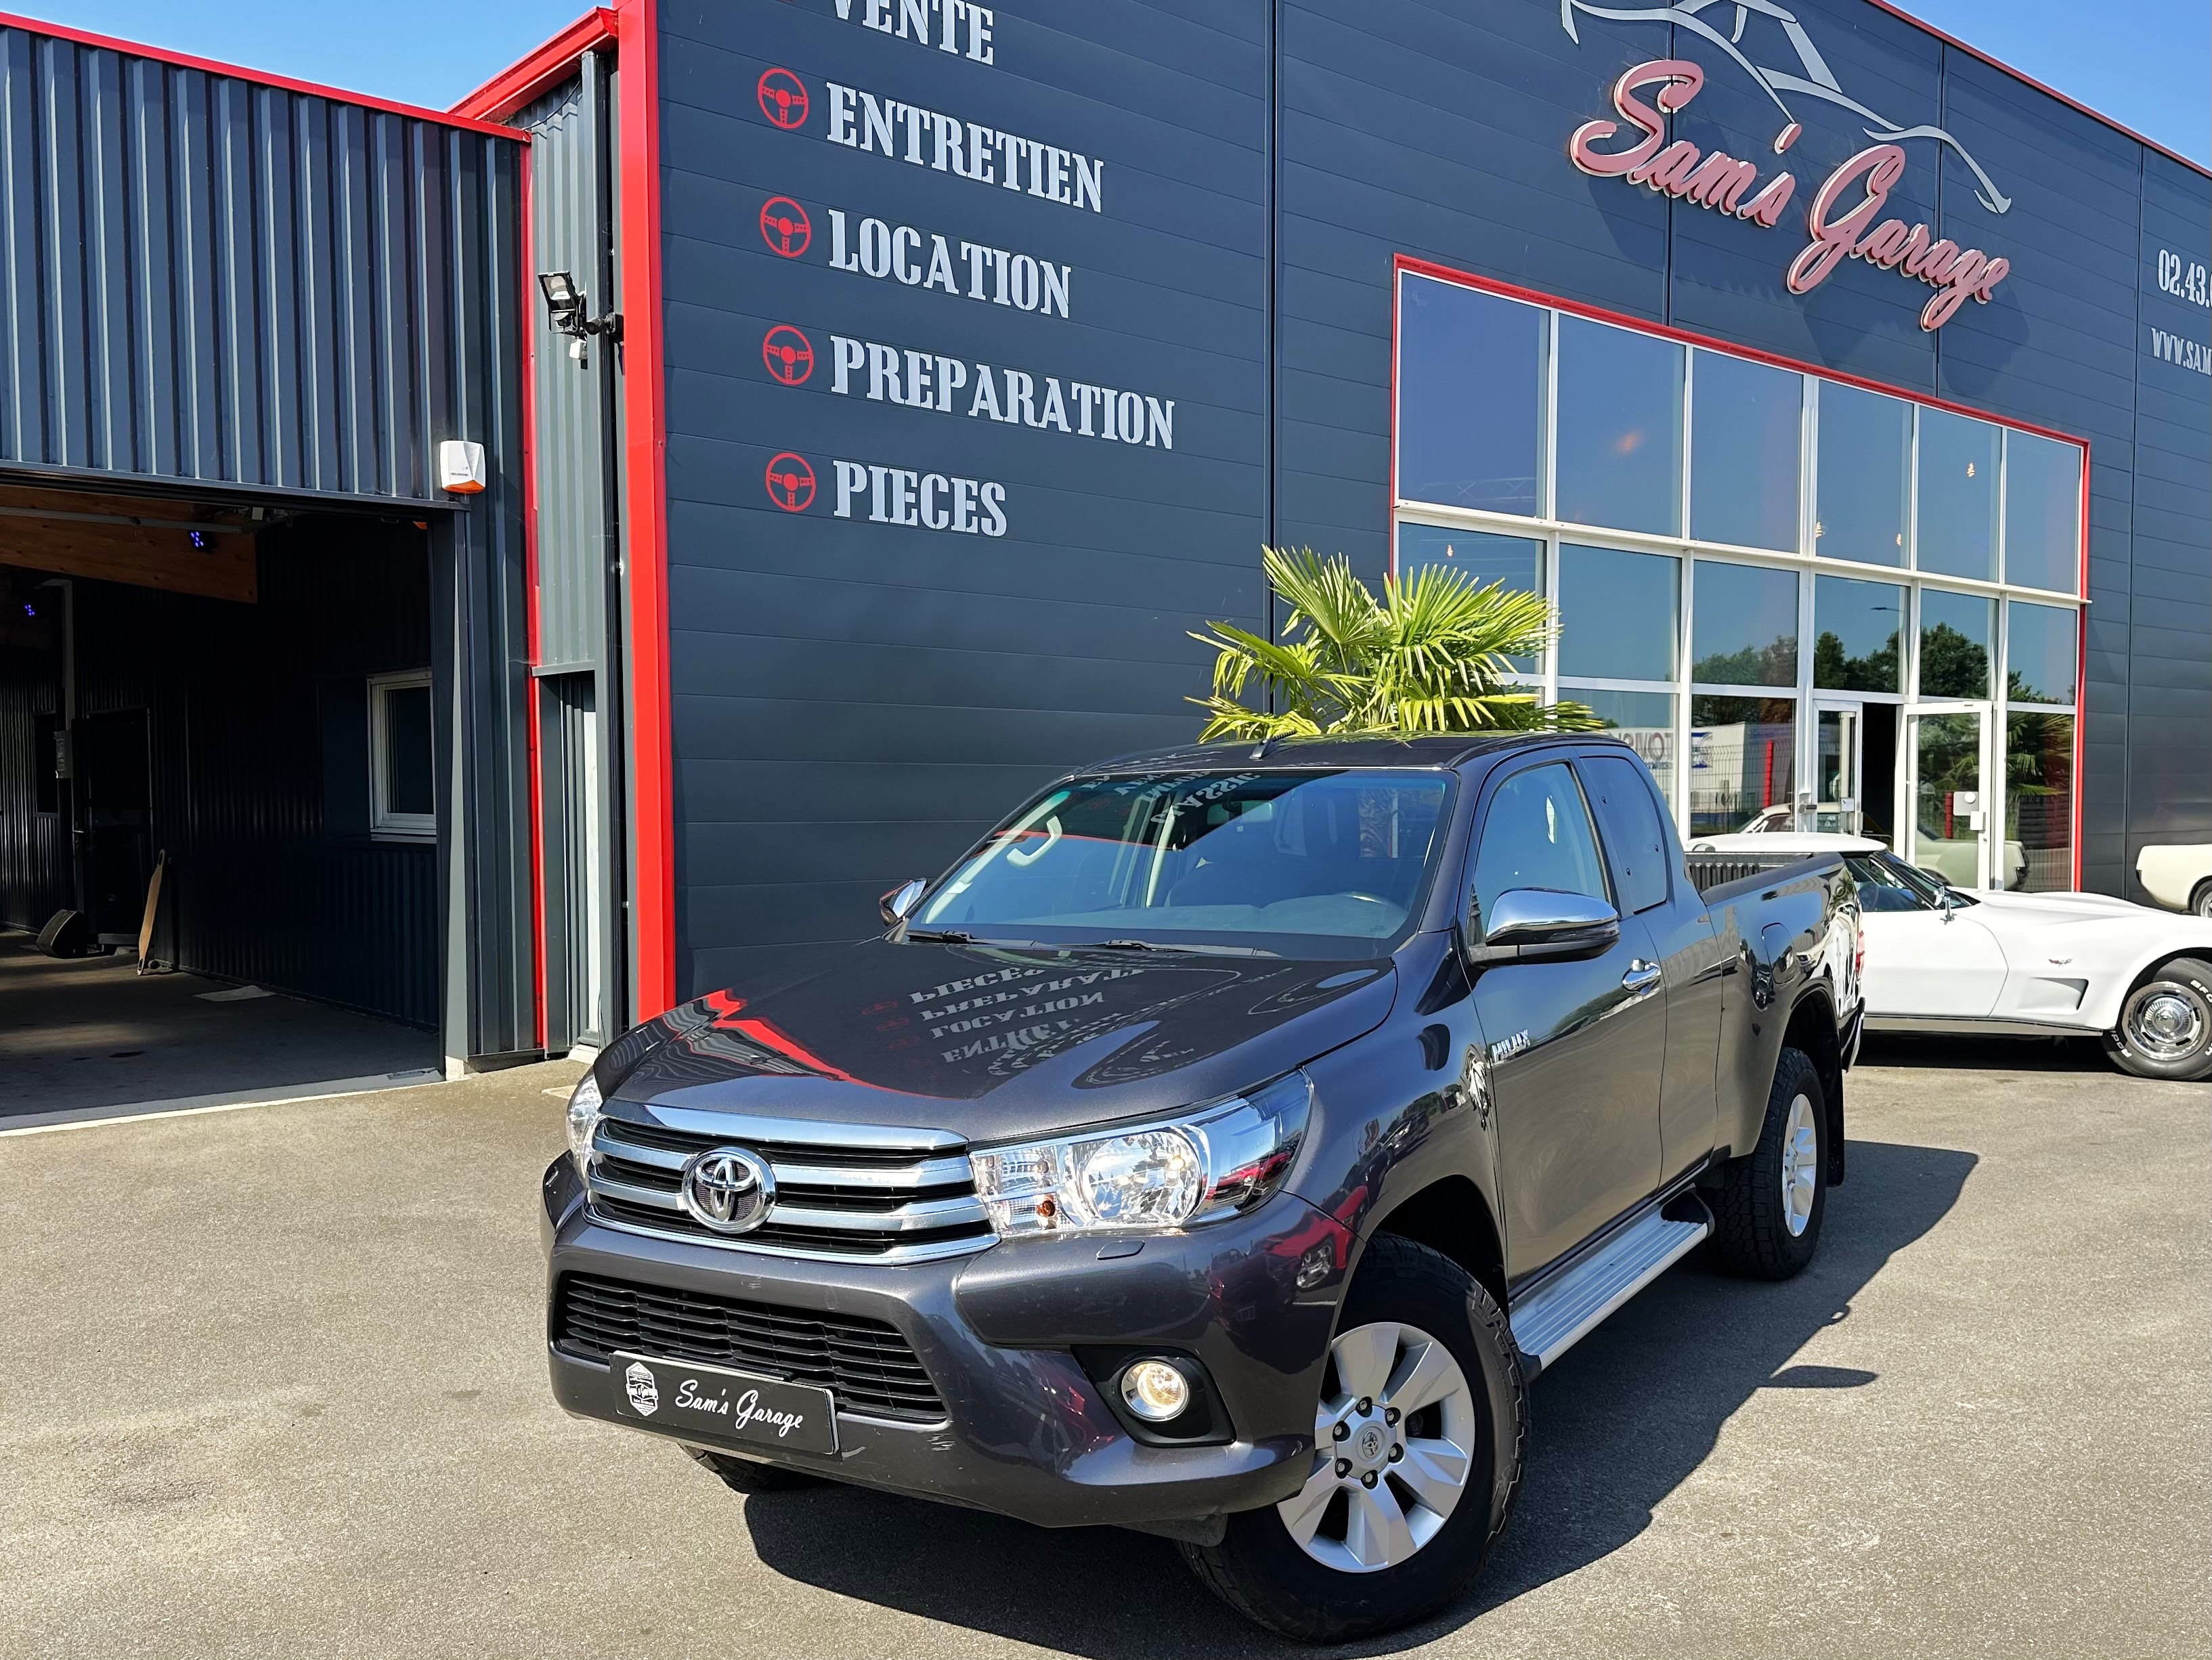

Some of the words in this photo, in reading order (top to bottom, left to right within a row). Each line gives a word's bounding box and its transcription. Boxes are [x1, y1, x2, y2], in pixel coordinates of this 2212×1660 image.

[826, 81, 1104, 213] ENTRETIEN
[1569, 60, 1802, 228] Sam's
[1787, 144, 2010, 332] Garage
[828, 209, 1072, 319] LOCATION
[2158, 248, 2212, 308] 02.43.
[830, 334, 1175, 450] PREPARATION
[833, 460, 1008, 538] PIECES
[675, 1379, 728, 1415] Sam's
[735, 1389, 804, 1437] Garage
